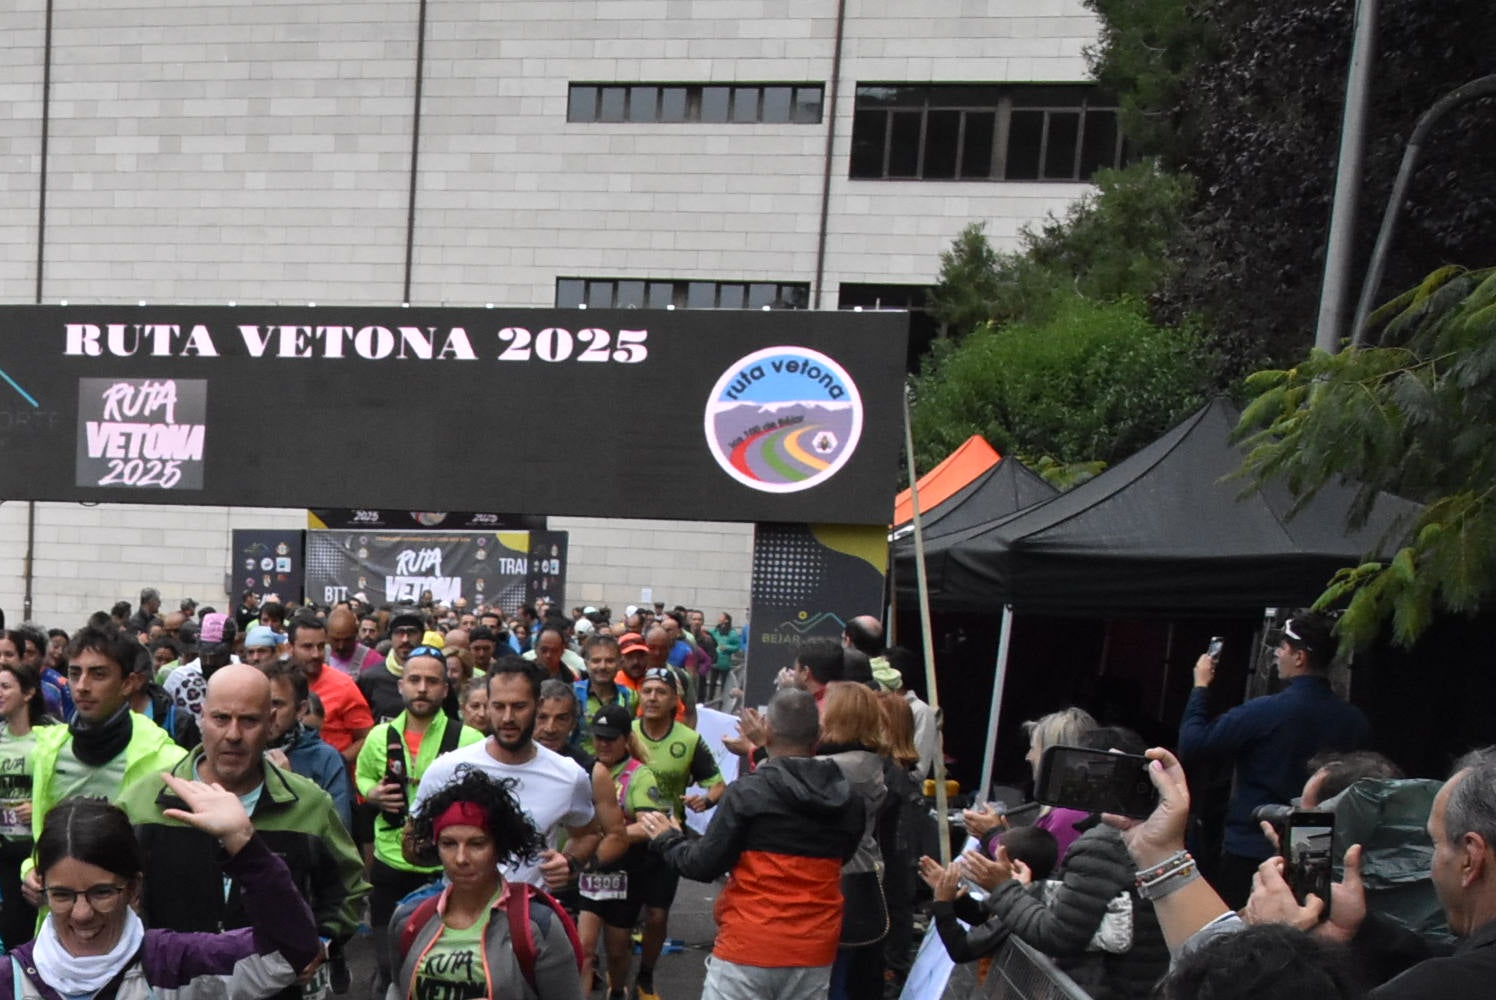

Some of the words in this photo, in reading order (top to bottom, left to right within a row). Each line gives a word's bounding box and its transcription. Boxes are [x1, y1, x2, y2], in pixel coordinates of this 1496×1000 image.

[63, 323, 220, 357] RUTA
[237, 324, 479, 360] VETONA
[497, 327, 648, 363] 2025
[726, 366, 766, 400] ruta
[771, 359, 845, 400] vetona
[102, 379, 177, 424] RUTA
[85, 422, 205, 461] VETONA
[98, 459, 182, 489] 2025
[395, 547, 442, 576] RUTA
[499, 557, 528, 575] TRAI
[324, 586, 348, 603] BTT
